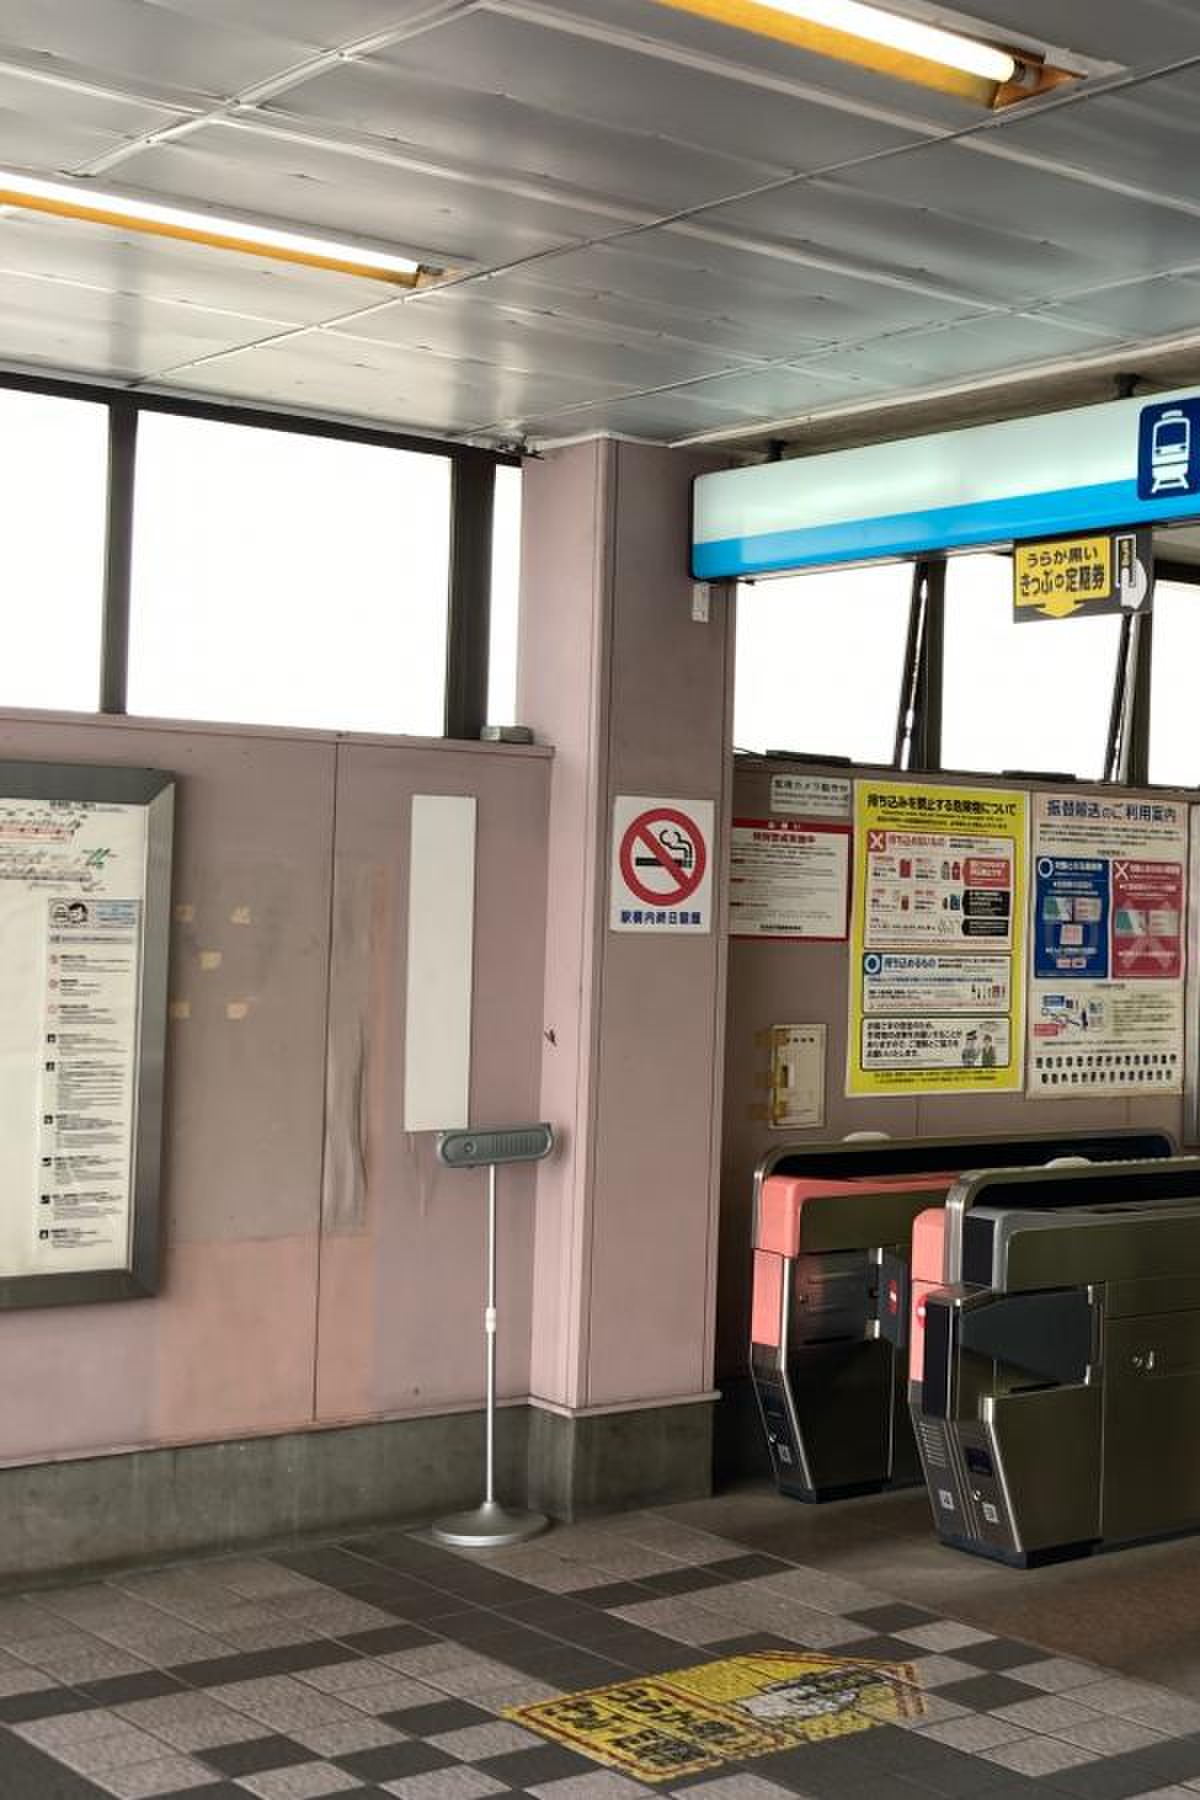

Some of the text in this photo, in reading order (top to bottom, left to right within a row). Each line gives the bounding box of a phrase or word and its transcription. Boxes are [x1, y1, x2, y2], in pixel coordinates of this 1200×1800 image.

[1027, 546, 1098, 568] うらが黒い
